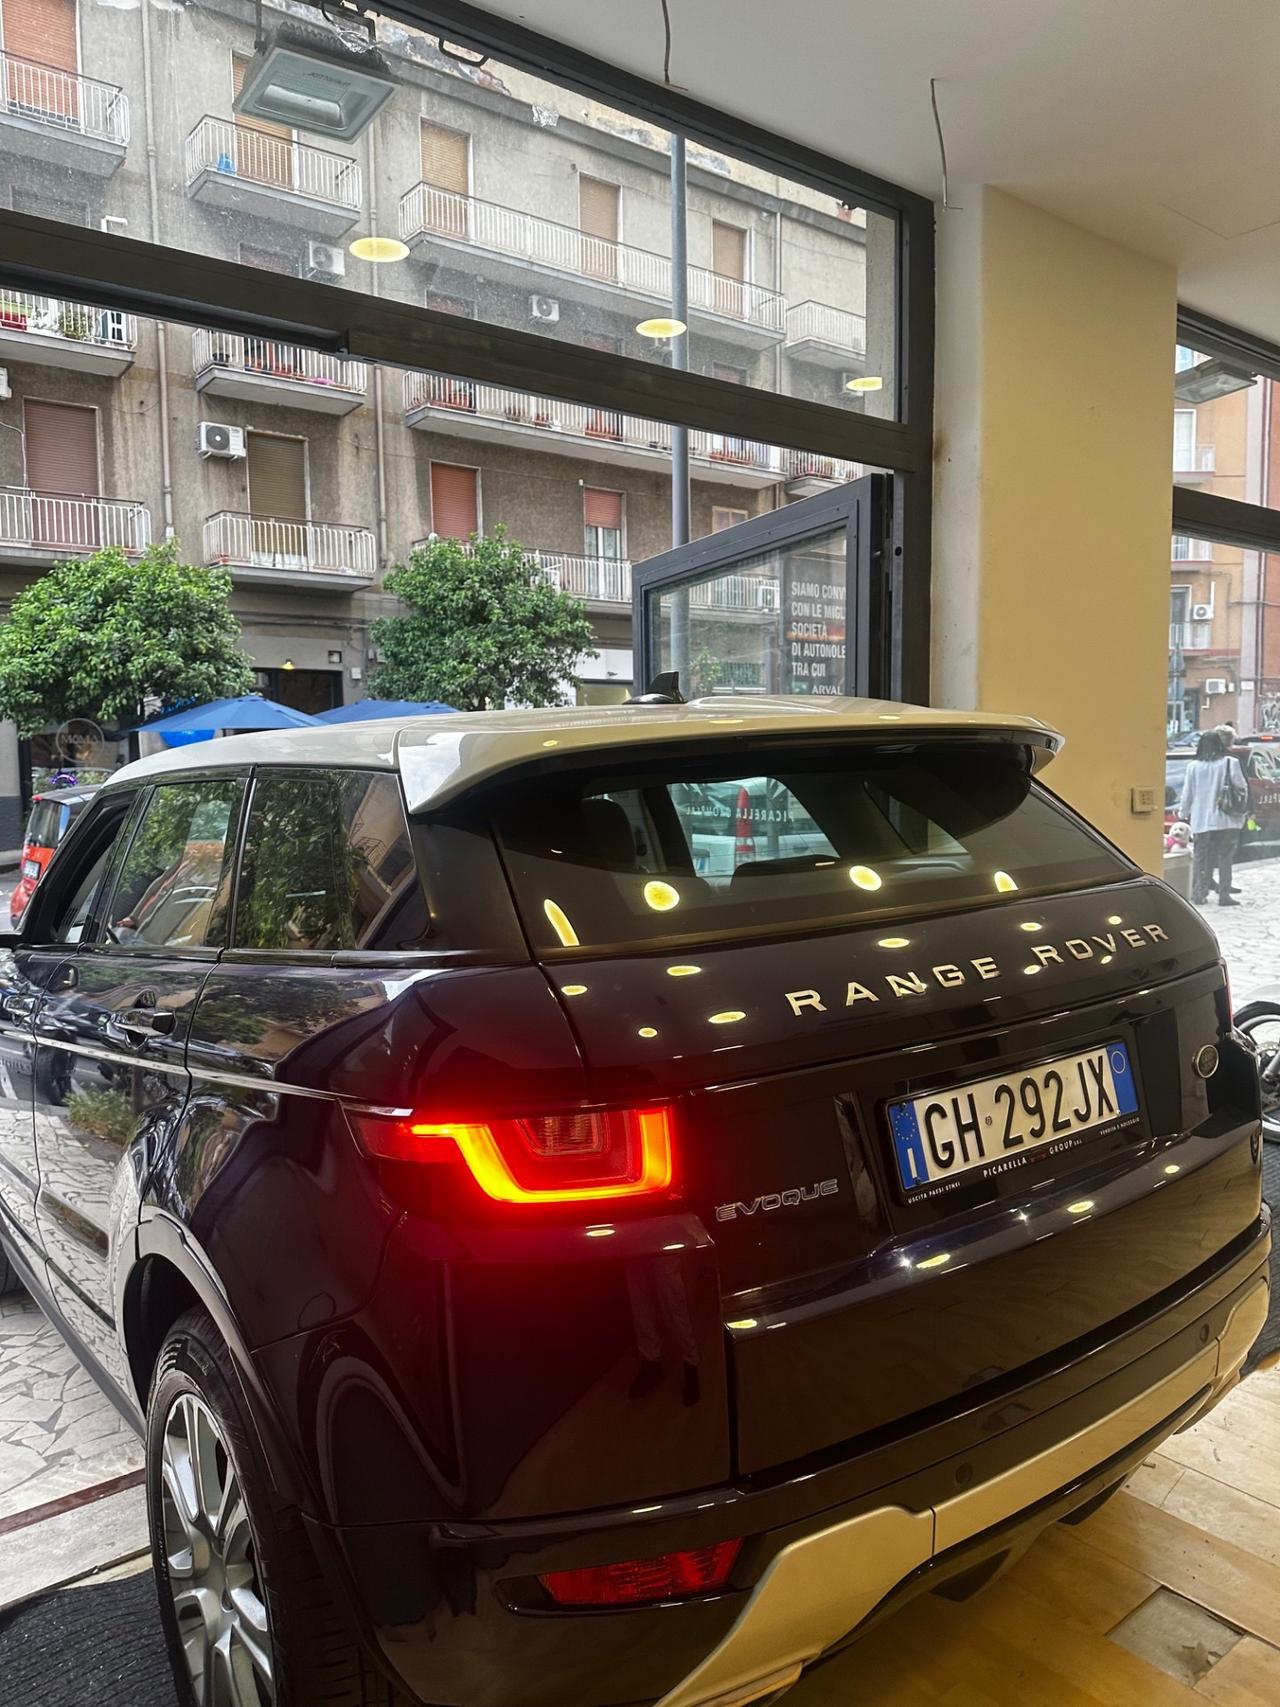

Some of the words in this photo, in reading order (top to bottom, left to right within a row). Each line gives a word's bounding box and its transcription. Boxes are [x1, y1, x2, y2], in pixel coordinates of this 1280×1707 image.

[791, 581, 820, 598] SIAMO
[791, 601, 810, 617] CON
[812, 602, 822, 618] LE
[791, 620, 828, 638] SOCIETÀ
[791, 642, 801, 656] DI
[791, 662, 809, 676] TRA
[811, 663, 826, 677] CUI
[811, 685, 844, 695] ARVAL
[785, 956, 1001, 1016] RANGE
[1031, 923, 1169, 968] ROVER
[924, 1092, 985, 1169] GH
[907, 1147, 918, 1179] I
[983, 1156, 1028, 1178] PICARELLA
[1049, 1139, 1073, 1155] GROUP
[715, 1178, 839, 1221] EVOQUE
